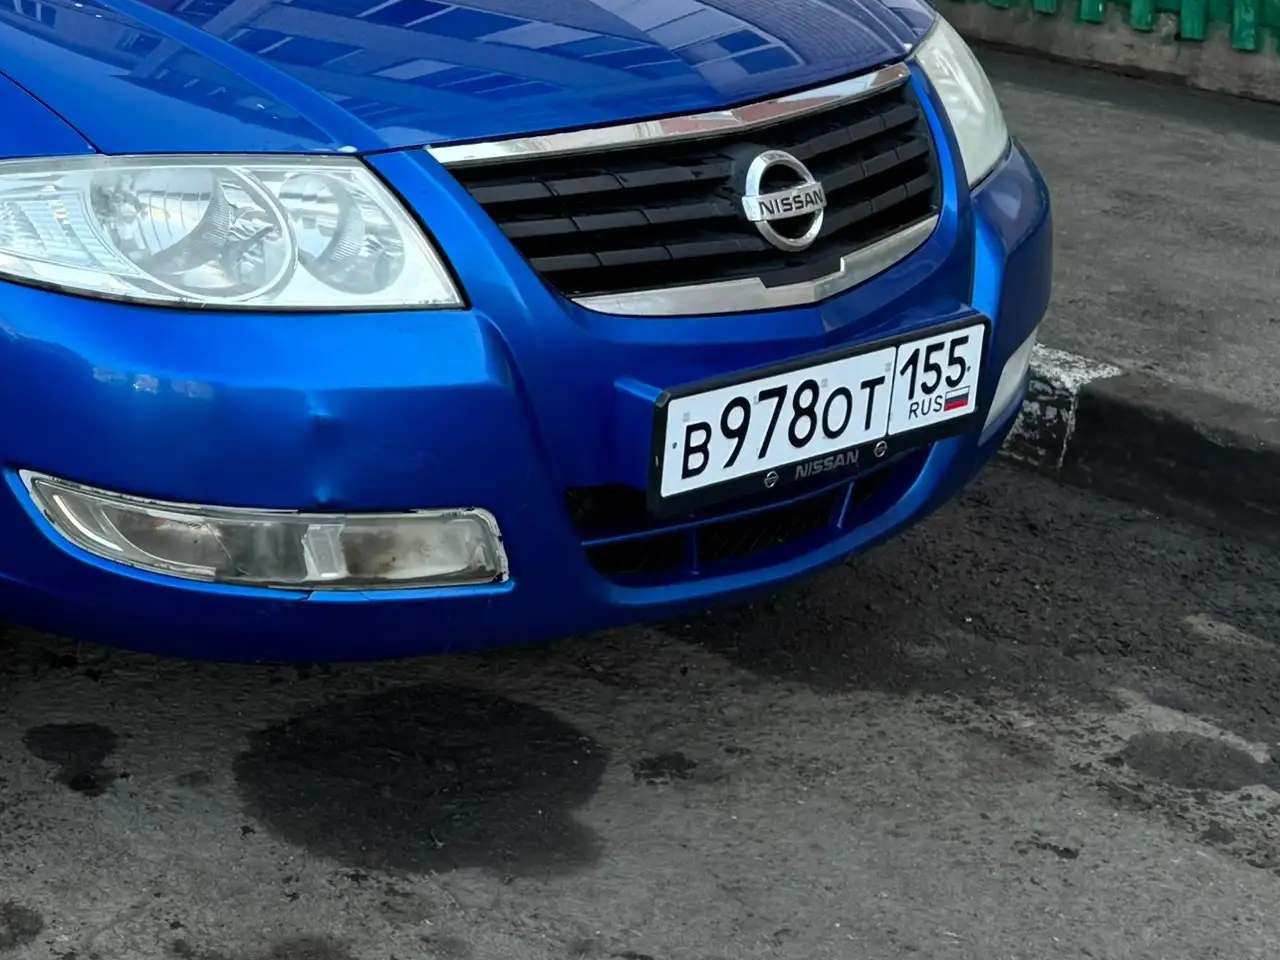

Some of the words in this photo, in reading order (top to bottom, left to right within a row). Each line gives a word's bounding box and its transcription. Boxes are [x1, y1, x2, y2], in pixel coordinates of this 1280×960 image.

[760, 190, 824, 215] NISSAN
[900, 335, 970, 400] 155
[908, 395, 943, 420] RUS
[795, 449, 859, 480] NISSAN
